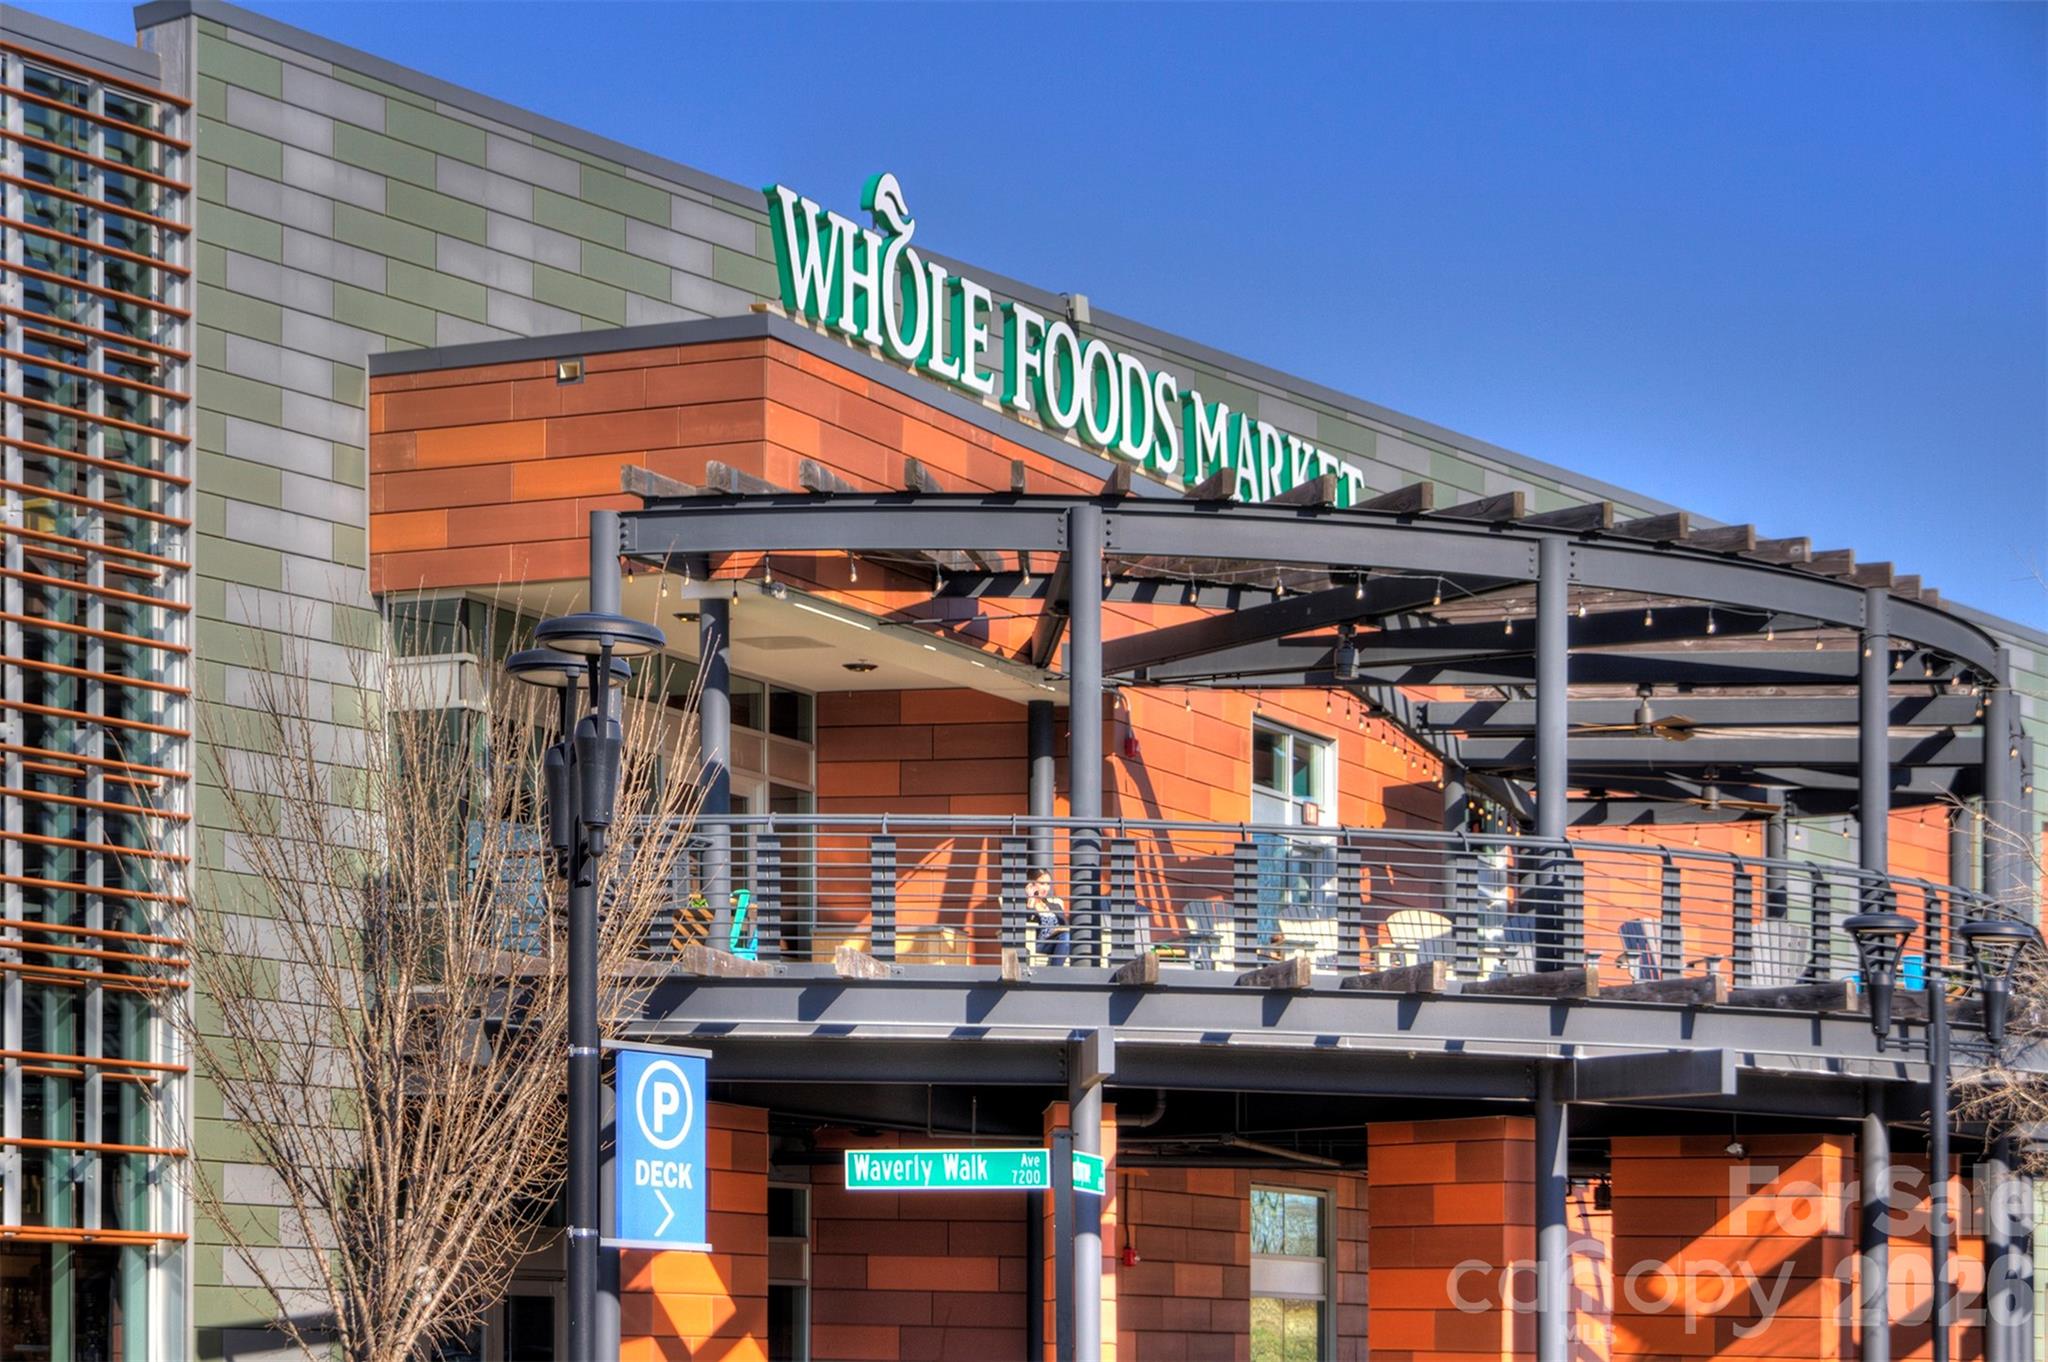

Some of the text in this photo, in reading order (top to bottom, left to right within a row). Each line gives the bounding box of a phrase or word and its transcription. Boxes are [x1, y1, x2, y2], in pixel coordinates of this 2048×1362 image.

[764, 173, 995, 396] WHOLE
[1001, 302, 1179, 475] FOODS
[653, 1081, 680, 1133] P
[635, 1159, 693, 1190] DECK
[853, 1153, 988, 1187] Waverly Walk
[1020, 1153, 1041, 1168] Ave
[1011, 1169, 1041, 1185] 7200
